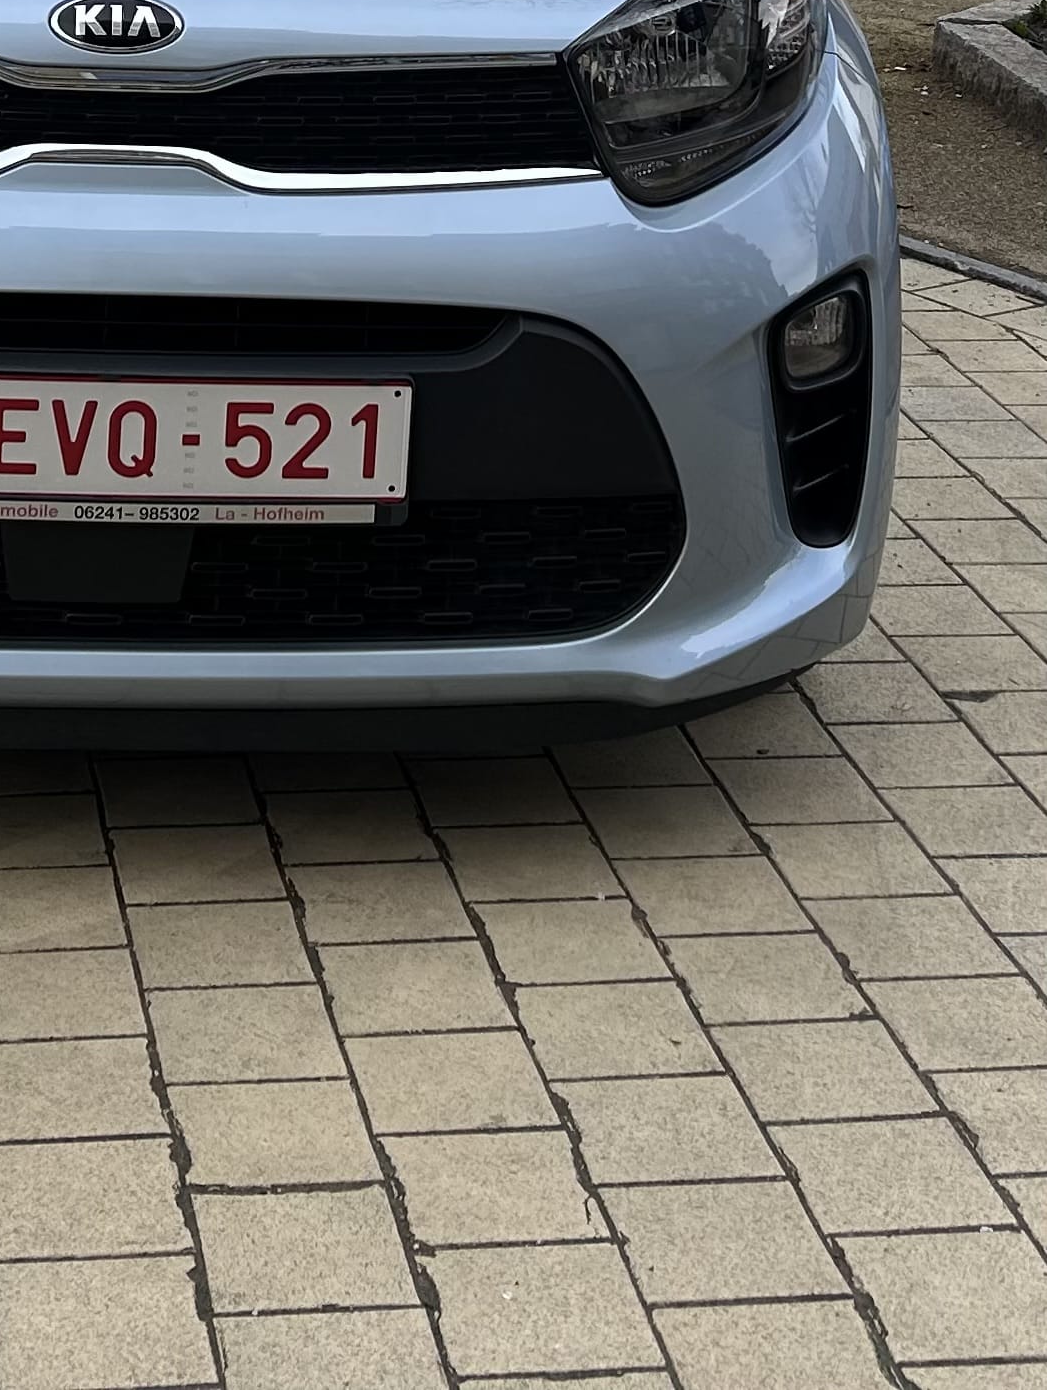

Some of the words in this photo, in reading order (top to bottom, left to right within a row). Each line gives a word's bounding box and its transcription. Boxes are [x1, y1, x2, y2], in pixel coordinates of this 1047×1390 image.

[74, 4, 161, 38] KIA
[215, 506, 235, 521] La
[253, 506, 325, 521] Hofheim
